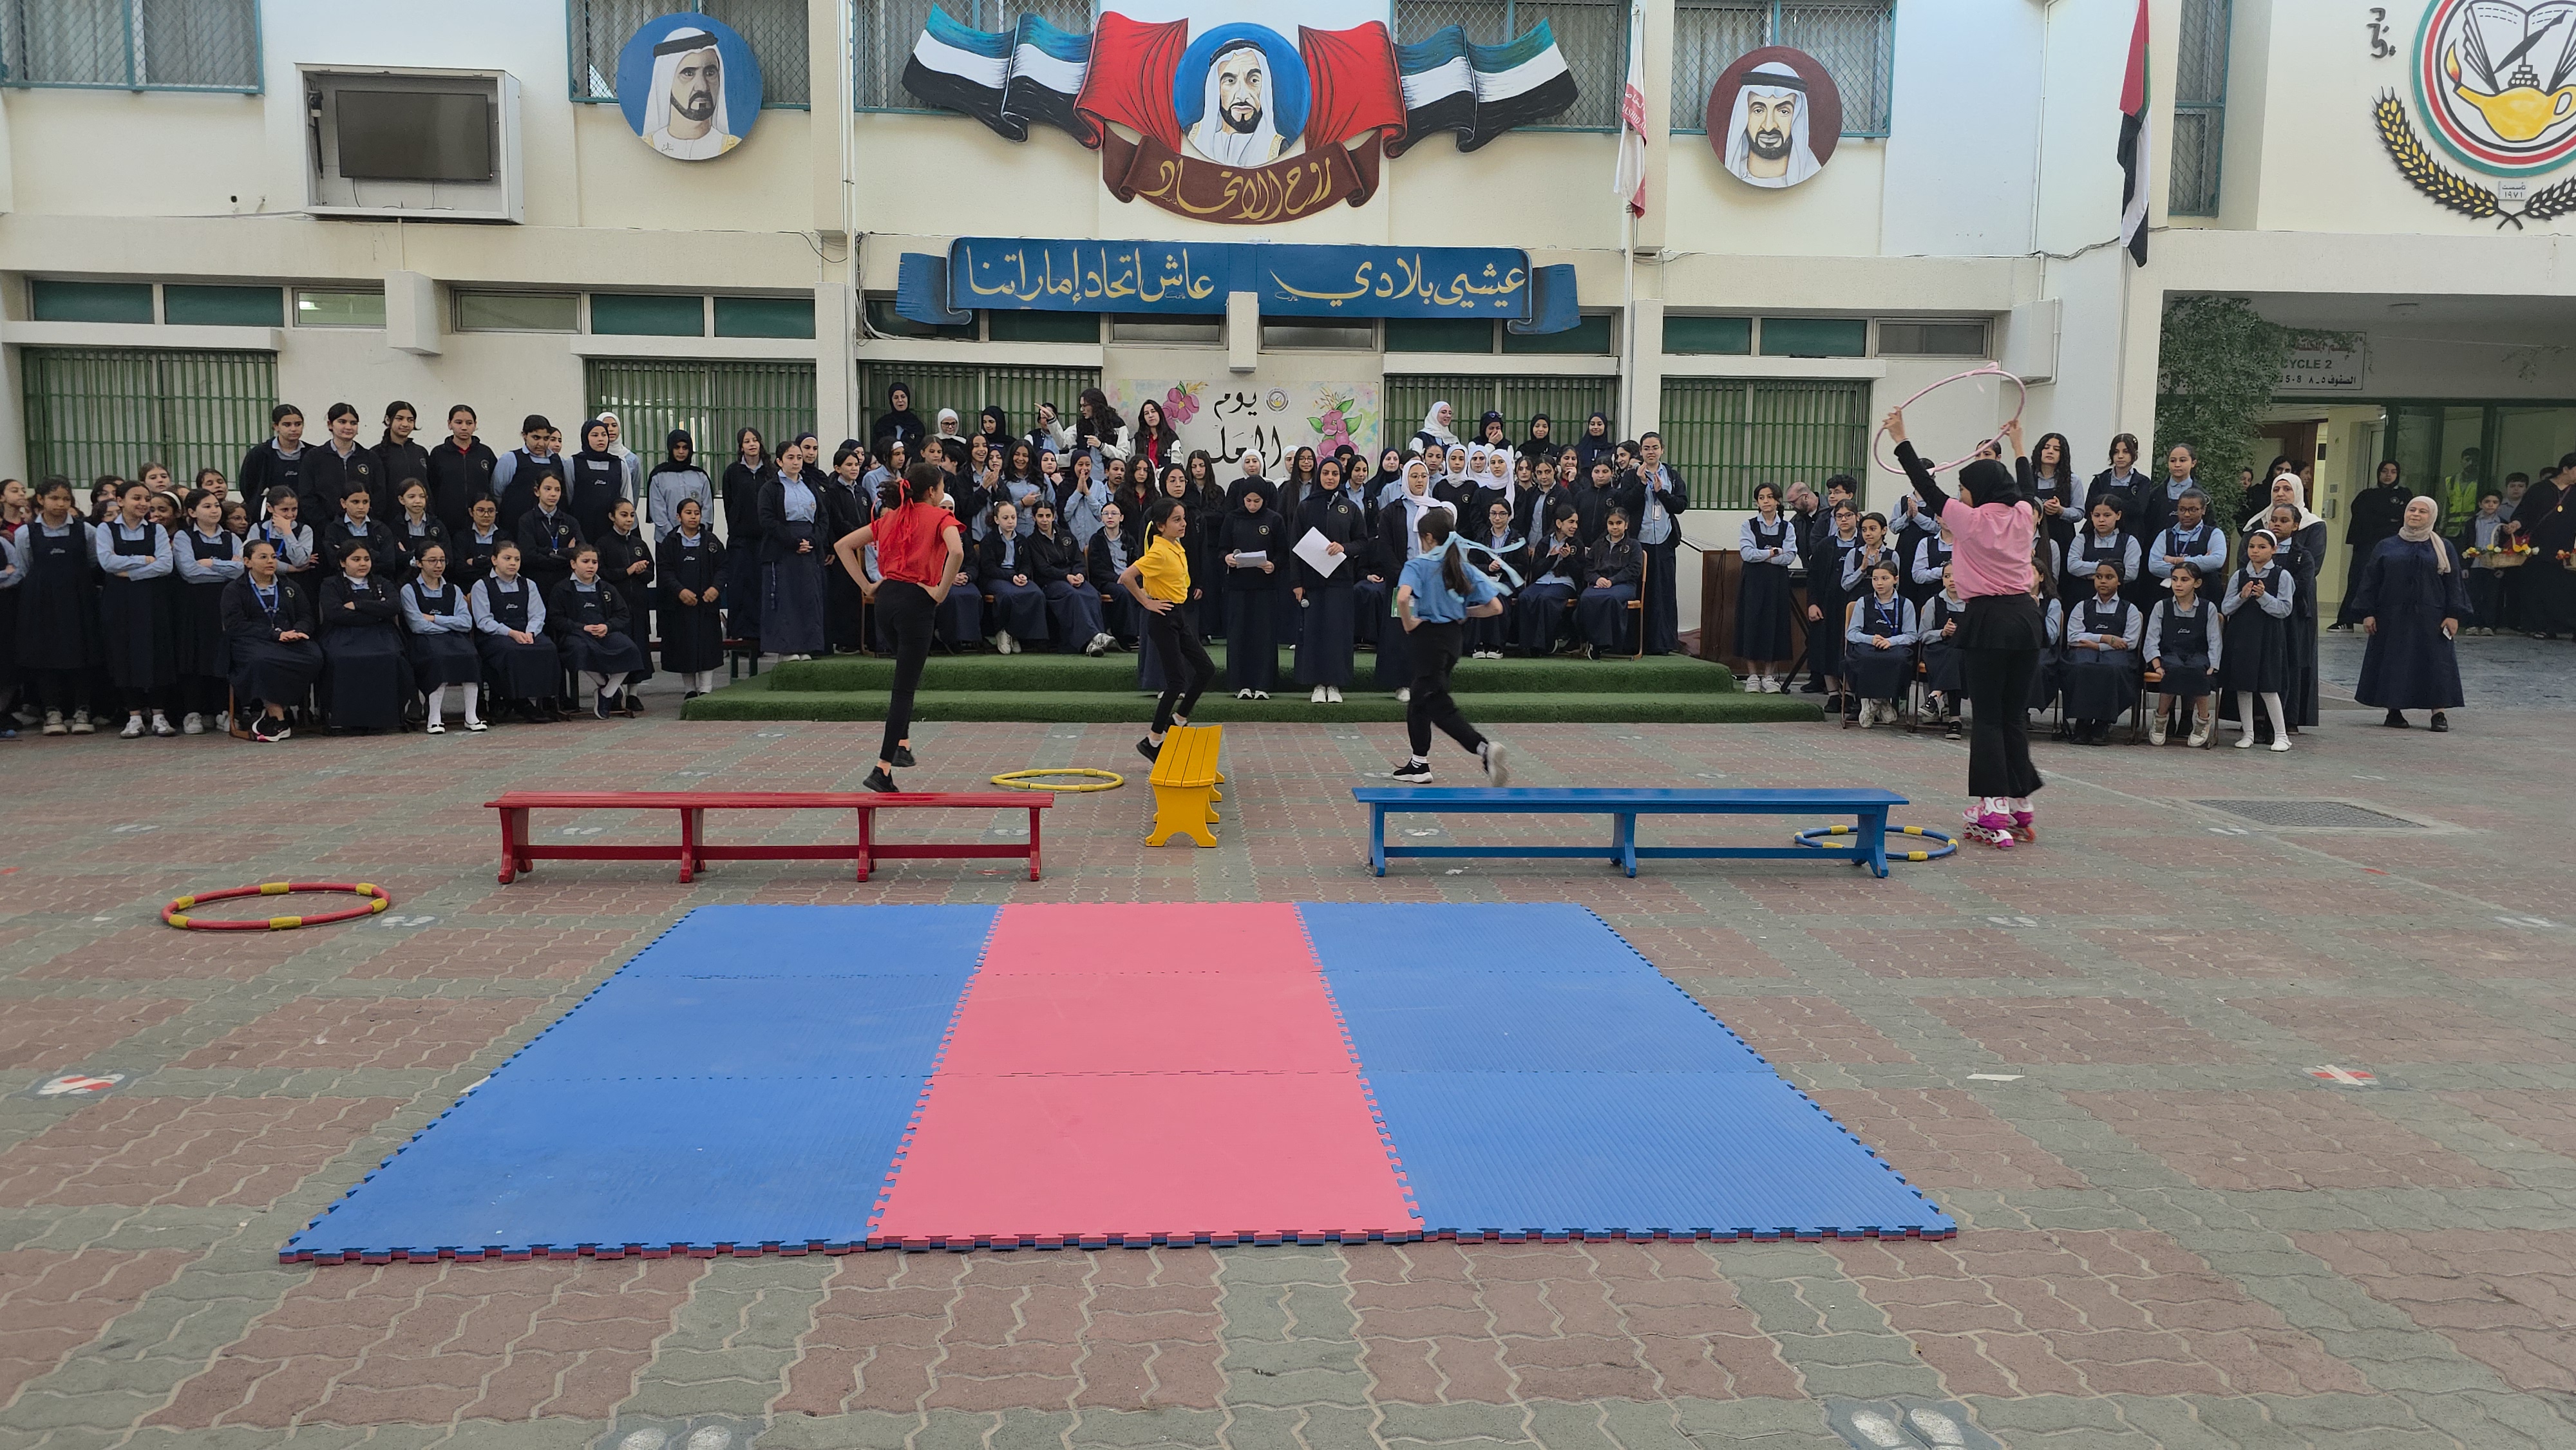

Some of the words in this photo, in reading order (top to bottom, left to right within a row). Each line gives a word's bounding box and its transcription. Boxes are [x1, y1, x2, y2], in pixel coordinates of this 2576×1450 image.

[1622, 104, 1640, 124] RASHID
[1139, 158, 1283, 221] الاتحاد
[1285, 157, 1331, 214] روح
[966, 245, 1083, 305] إماراتنا
[1084, 247, 1141, 298] اتحاد
[1139, 248, 1215, 303] عاش
[1269, 253, 1434, 306] بلادي
[1434, 263, 1526, 308] عيشي
[2325, 359, 2332, 369] 2
[1214, 391, 1258, 422] يوم
